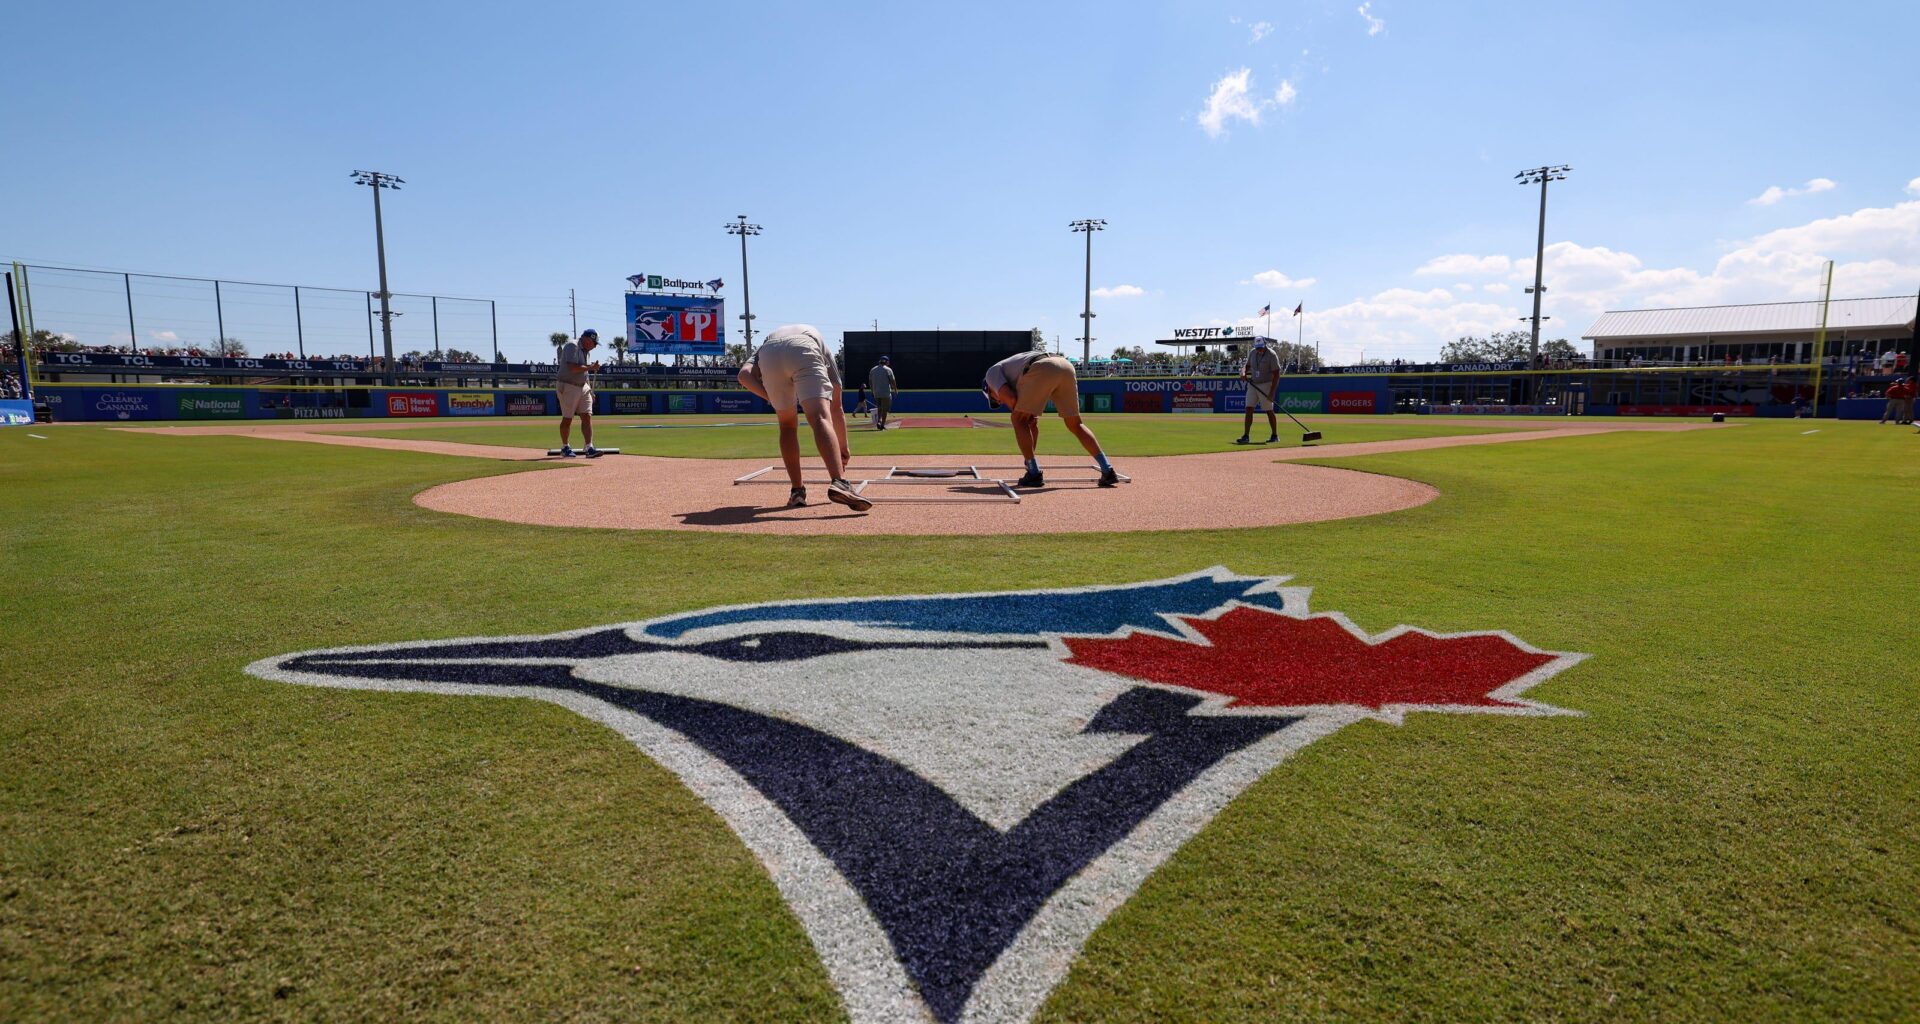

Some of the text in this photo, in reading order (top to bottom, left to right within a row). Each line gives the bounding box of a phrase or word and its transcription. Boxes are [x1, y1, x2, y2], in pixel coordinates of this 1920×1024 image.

[663, 279, 704, 289] Ballpark
[1174, 328, 1221, 339] WESTJET
[56, 354, 93, 364] TCL
[121, 356, 154, 366] TCL
[180, 358, 211, 367] TCL
[235, 360, 264, 368] TCL
[286, 361, 312, 369] TCL
[332, 362, 359, 370] TCL
[1451, 363, 1514, 372] CANADA DRY
[1125, 381, 1247, 391] TORONTO BLUE JAY
[101, 393, 143, 403] CLEARLY
[410, 397, 435, 405] Here's
[451, 397, 493, 408] Frenchy's
[1281, 397, 1320, 409] Sobeys
[96, 402, 148, 411] CANADIAN
[195, 400, 240, 409] National
[1096, 398, 1110, 409] TD
[294, 408, 344, 418] PIZZA NOVA
